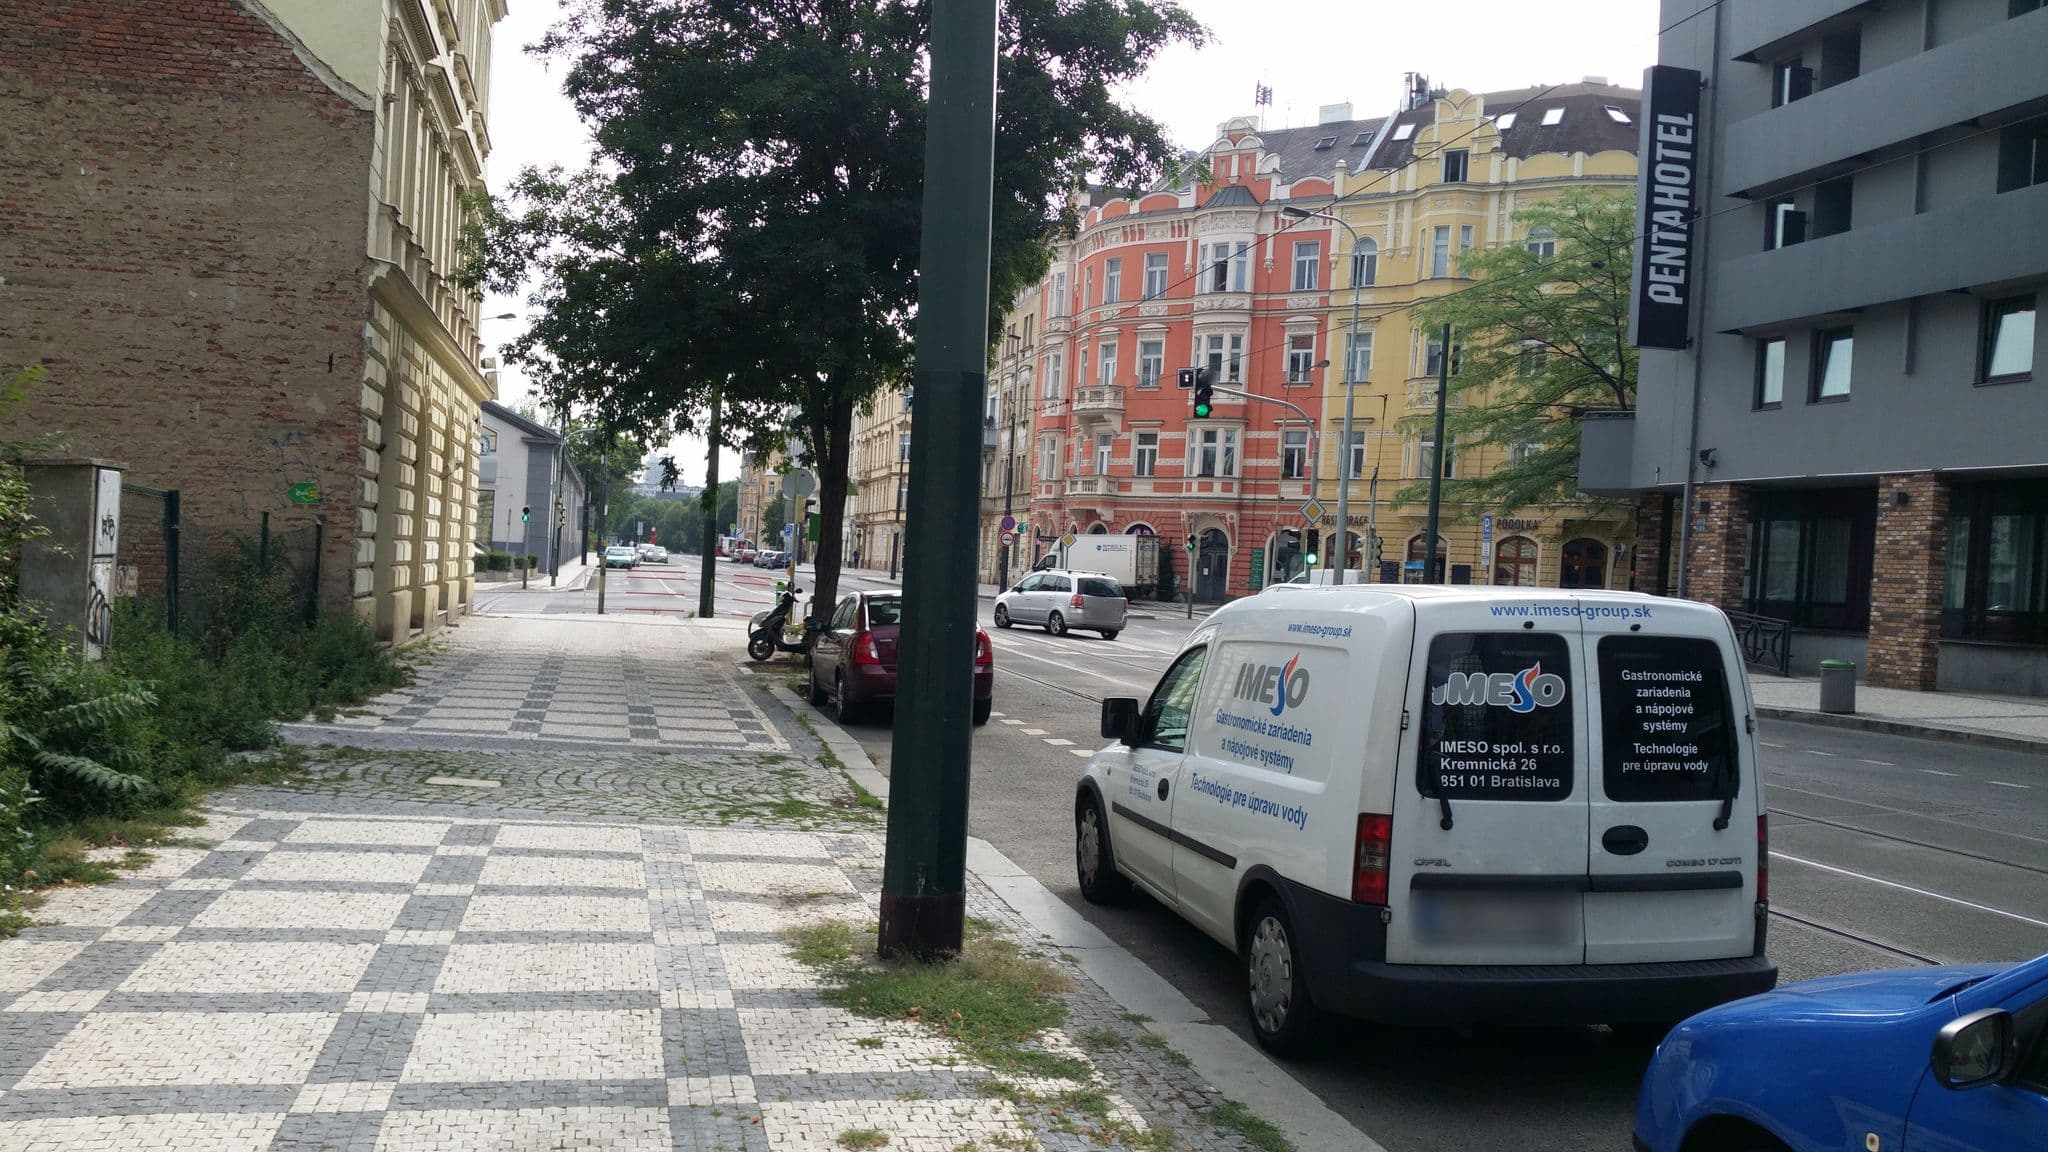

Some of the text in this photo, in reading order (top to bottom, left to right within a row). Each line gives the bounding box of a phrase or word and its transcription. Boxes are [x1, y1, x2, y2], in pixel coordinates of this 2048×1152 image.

[1648, 112, 1694, 305] PENTAHOTEL
[1496, 518, 1539, 530] PODOLKA
[1490, 604, 1652, 620] www.imeso-group.sk
[1288, 623, 1352, 638] www.imeso-group.sk
[1621, 670, 1703, 682] Gastronomické
[1233, 652, 1310, 716] IMESO
[1636, 686, 1691, 698] zariadenia
[1635, 702, 1694, 717] a nápojové
[1216, 709, 1312, 747] Gastronomické zariadenia
[1643, 719, 1688, 734] systémy
[1221, 737, 1294, 774] a nápojové systémy
[1440, 741, 1565, 757] IMESO spol. s r.o.
[1633, 742, 1698, 757] Technologie
[1440, 758, 1537, 771] Kremnická 26
[1622, 760, 1709, 774] pre úpravu vody
[1440, 775, 1560, 788] 851 01 Bratislava
[1191, 772, 1308, 831] Technologie pre úpravu vody
[1413, 857, 1452, 867] OPEL
